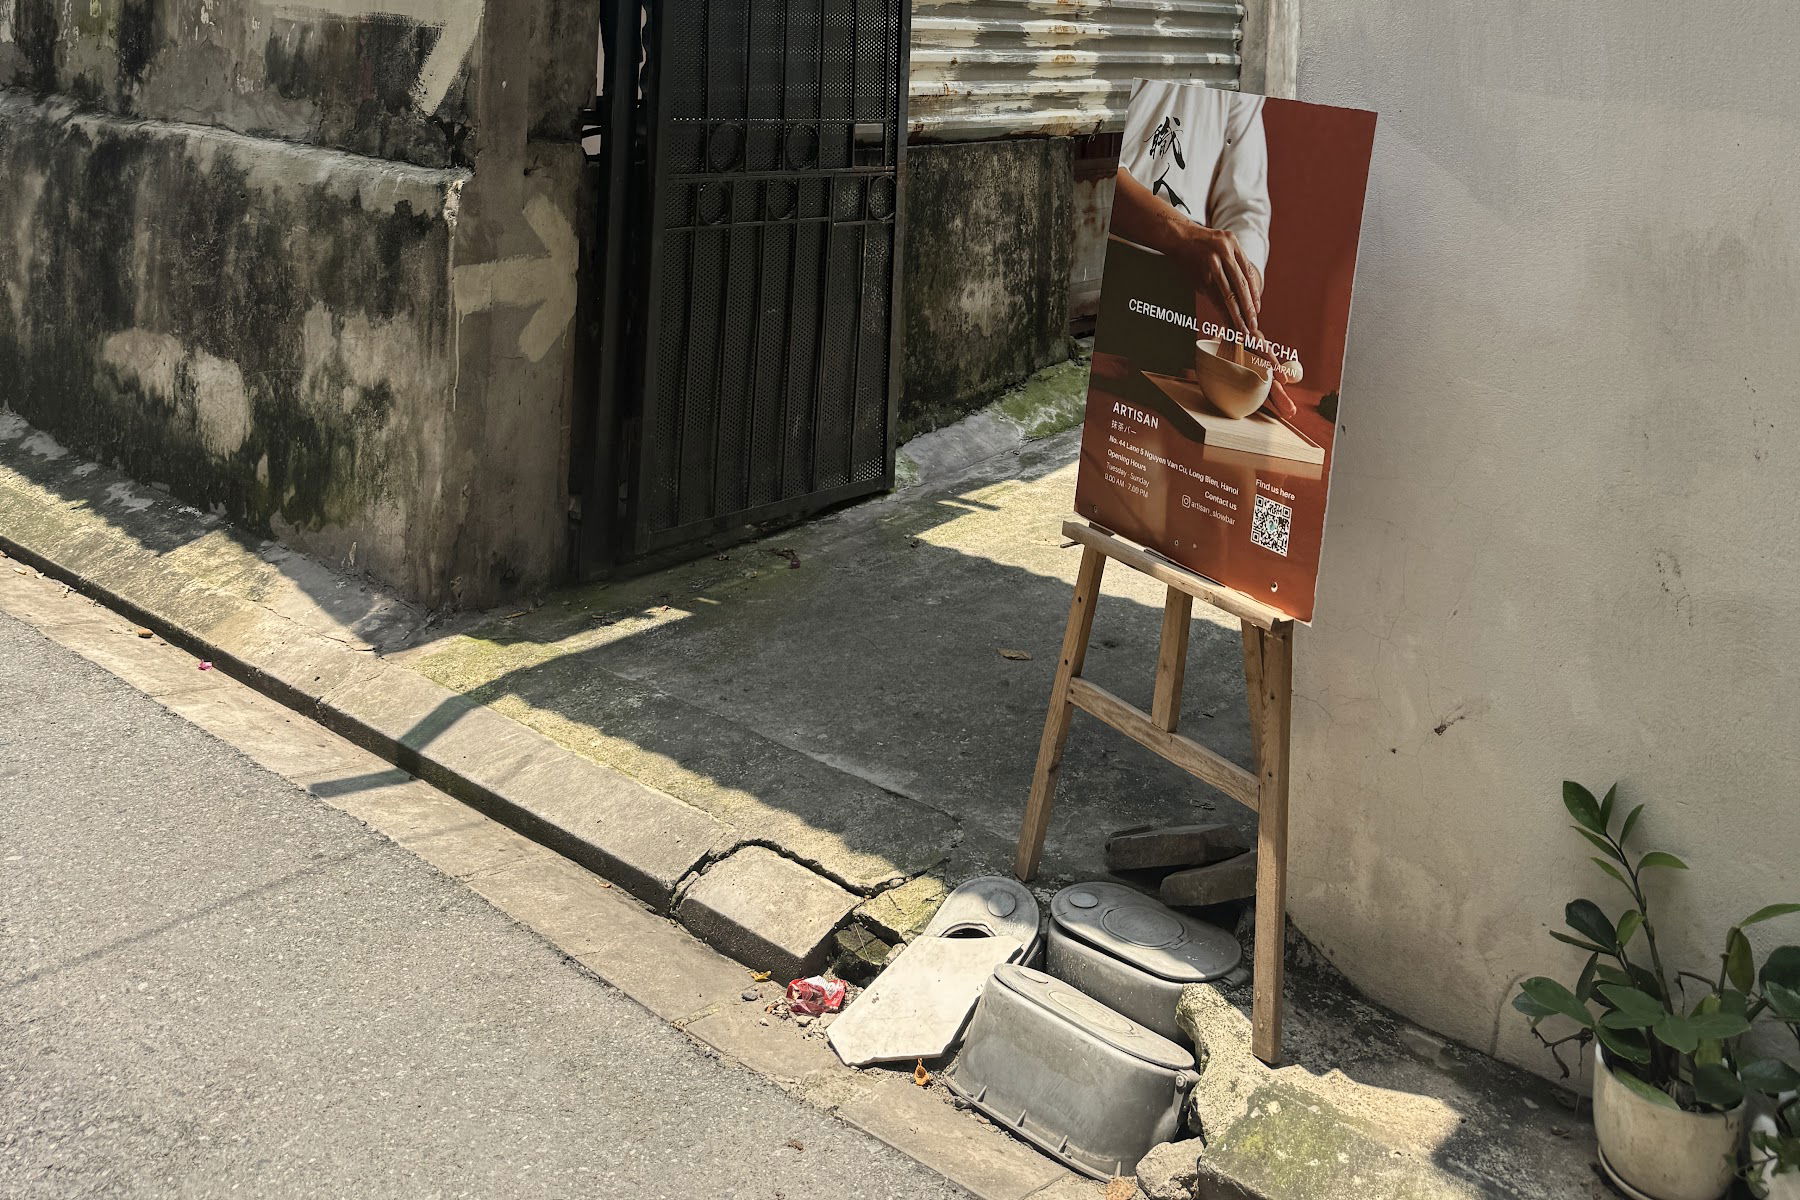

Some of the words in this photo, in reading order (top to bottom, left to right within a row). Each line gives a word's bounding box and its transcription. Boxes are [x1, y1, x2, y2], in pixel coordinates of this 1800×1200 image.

[1128, 298, 1200, 332] CEREMONIAL
[1201, 321, 1244, 345] GRADE
[1244, 333, 1299, 362] MATCHA
[1112, 401, 1159, 430] ARTISAN
[1107, 448, 1130, 466] Opening
[1130, 459, 1147, 472] Hours
[1118, 439, 1126, 448] 44
[1166, 458, 1178, 471] Van
[1188, 468, 1204, 483] Long
[1220, 482, 1239, 496] Hanoi
[1115, 479, 1125, 488] AM
[1139, 488, 1149, 498] PM
[1130, 472, 1150, 488] Sunday
[1255, 478, 1271, 491] Find
[1270, 485, 1280, 495] us
[1279, 488, 1296, 501] here
[1204, 490, 1229, 508] Contact
[1228, 502, 1238, 511] us
